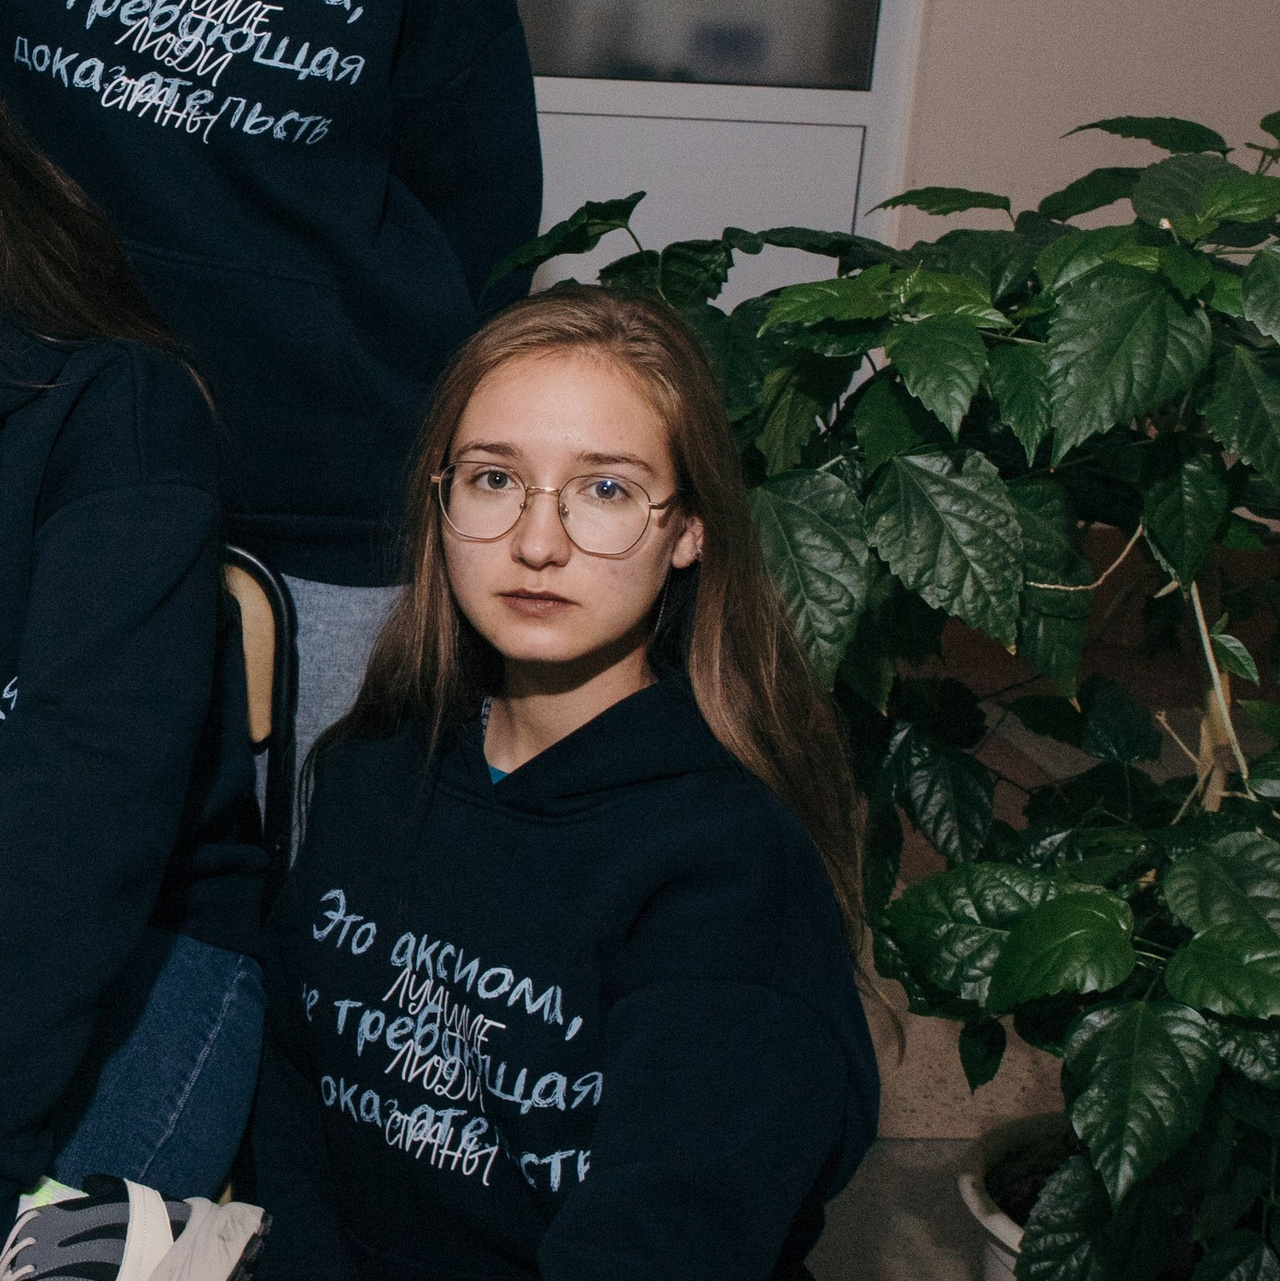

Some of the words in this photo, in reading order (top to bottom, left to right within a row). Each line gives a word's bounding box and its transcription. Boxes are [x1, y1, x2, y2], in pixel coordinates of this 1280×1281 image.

[114, 18, 234, 87] ЛЮДИ
[101, 76, 224, 144] СТРАНЫ
[313, 889, 376, 955] Это
[385, 1039, 486, 1113] ЛЮДИ
[384, 1109, 499, 1187] СТРАНЫ
